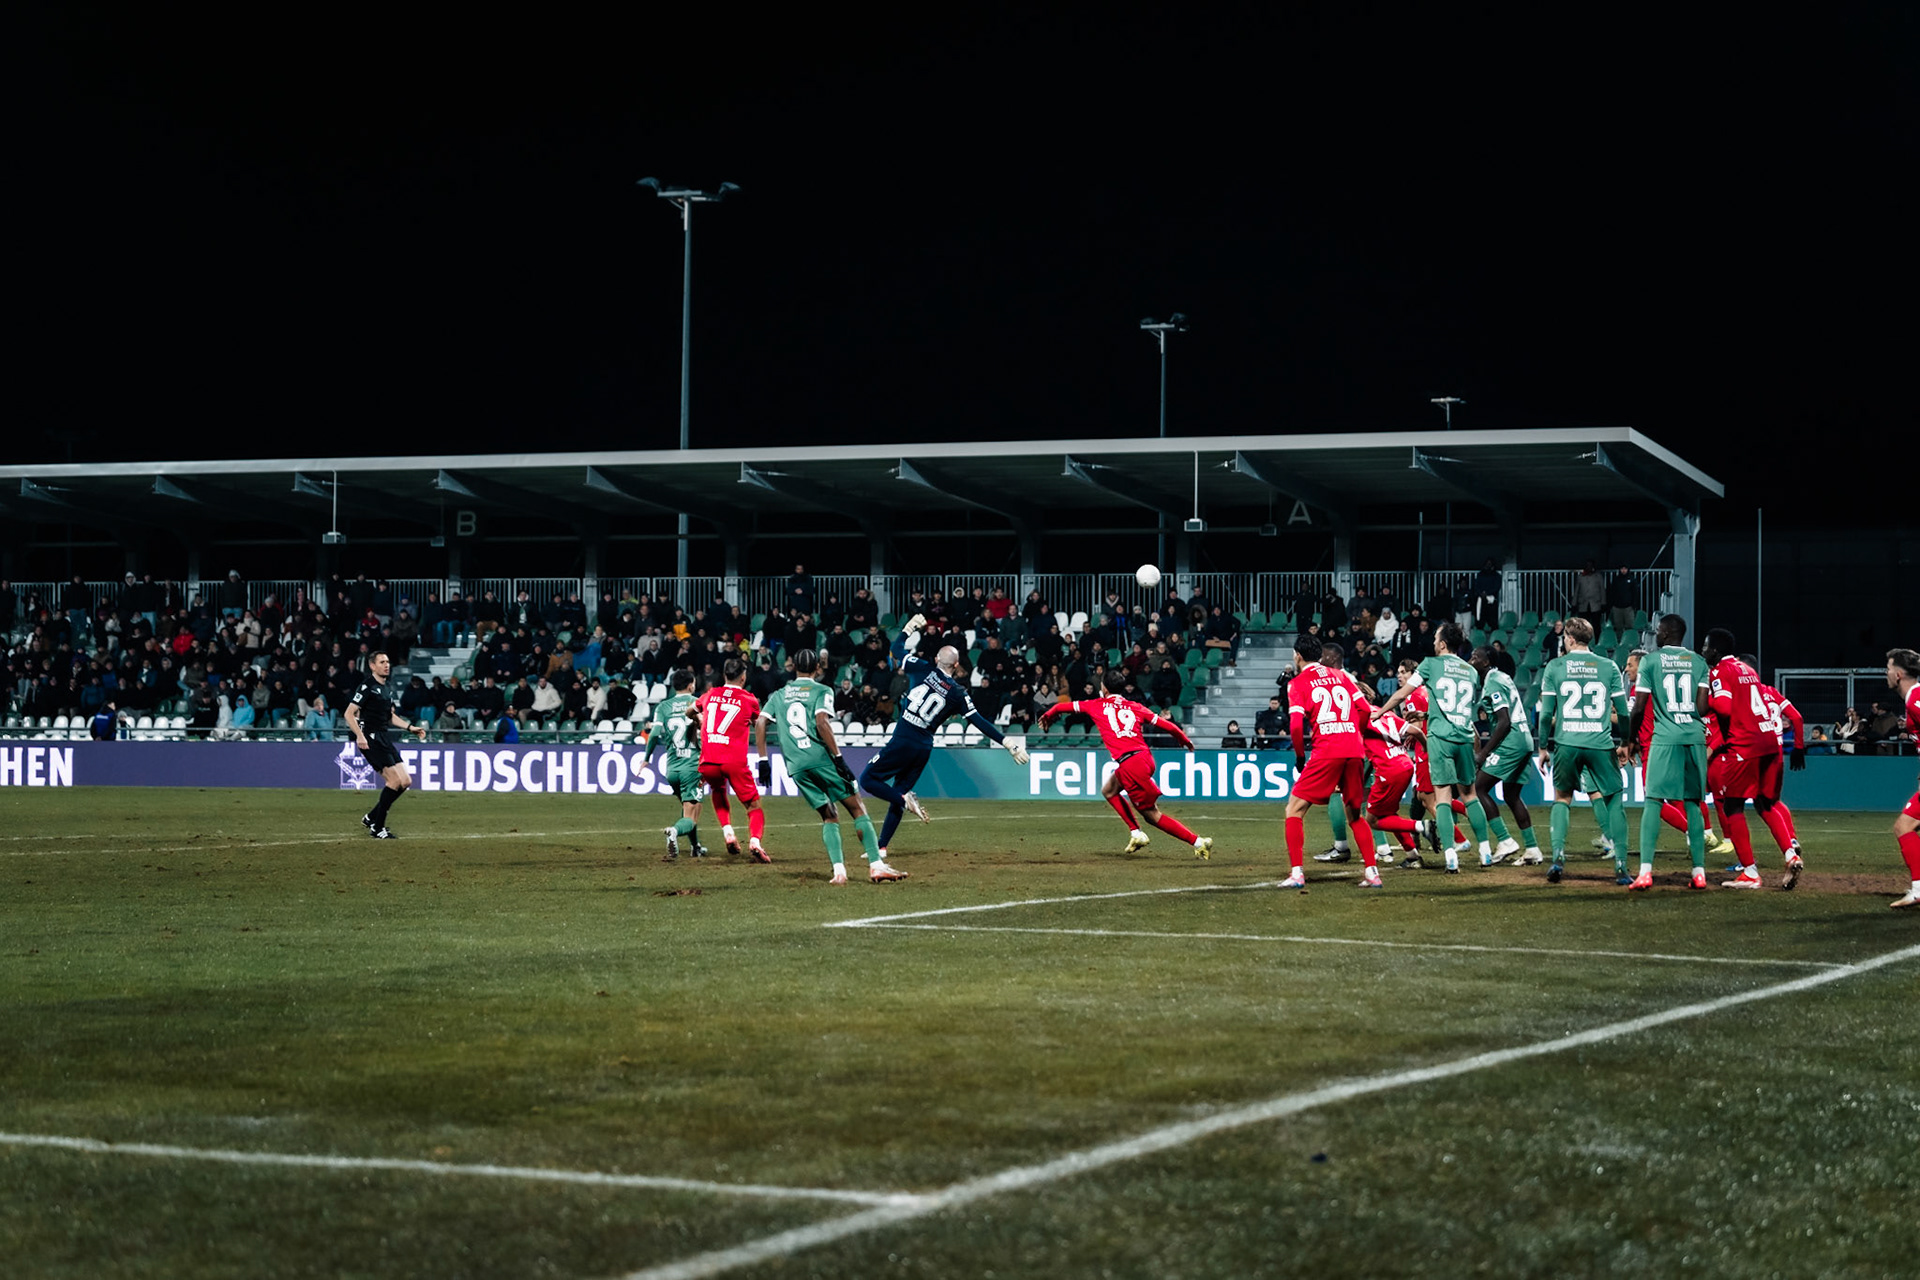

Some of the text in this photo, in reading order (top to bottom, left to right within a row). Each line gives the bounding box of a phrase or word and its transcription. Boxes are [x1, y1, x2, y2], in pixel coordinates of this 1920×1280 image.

[457, 510, 476, 536] B
[1287, 499, 1312, 525] A
[709, 695, 742, 707] HESTIA
[1310, 677, 1342, 688] HESTIA
[1436, 677, 1473, 717] 32
[1560, 681, 1606, 719] 23
[1662, 673, 1695, 712] 11
[706, 702, 741, 735] 17
[786, 702, 808, 740] 9
[907, 683, 946, 723] 40
[1103, 706, 1137, 734] 19
[1311, 685, 1352, 724] 29
[1750, 684, 1770, 720] 4
[0, 746, 74, 787] HEN
[399, 743, 798, 796] FELDSCHLÖSEN
